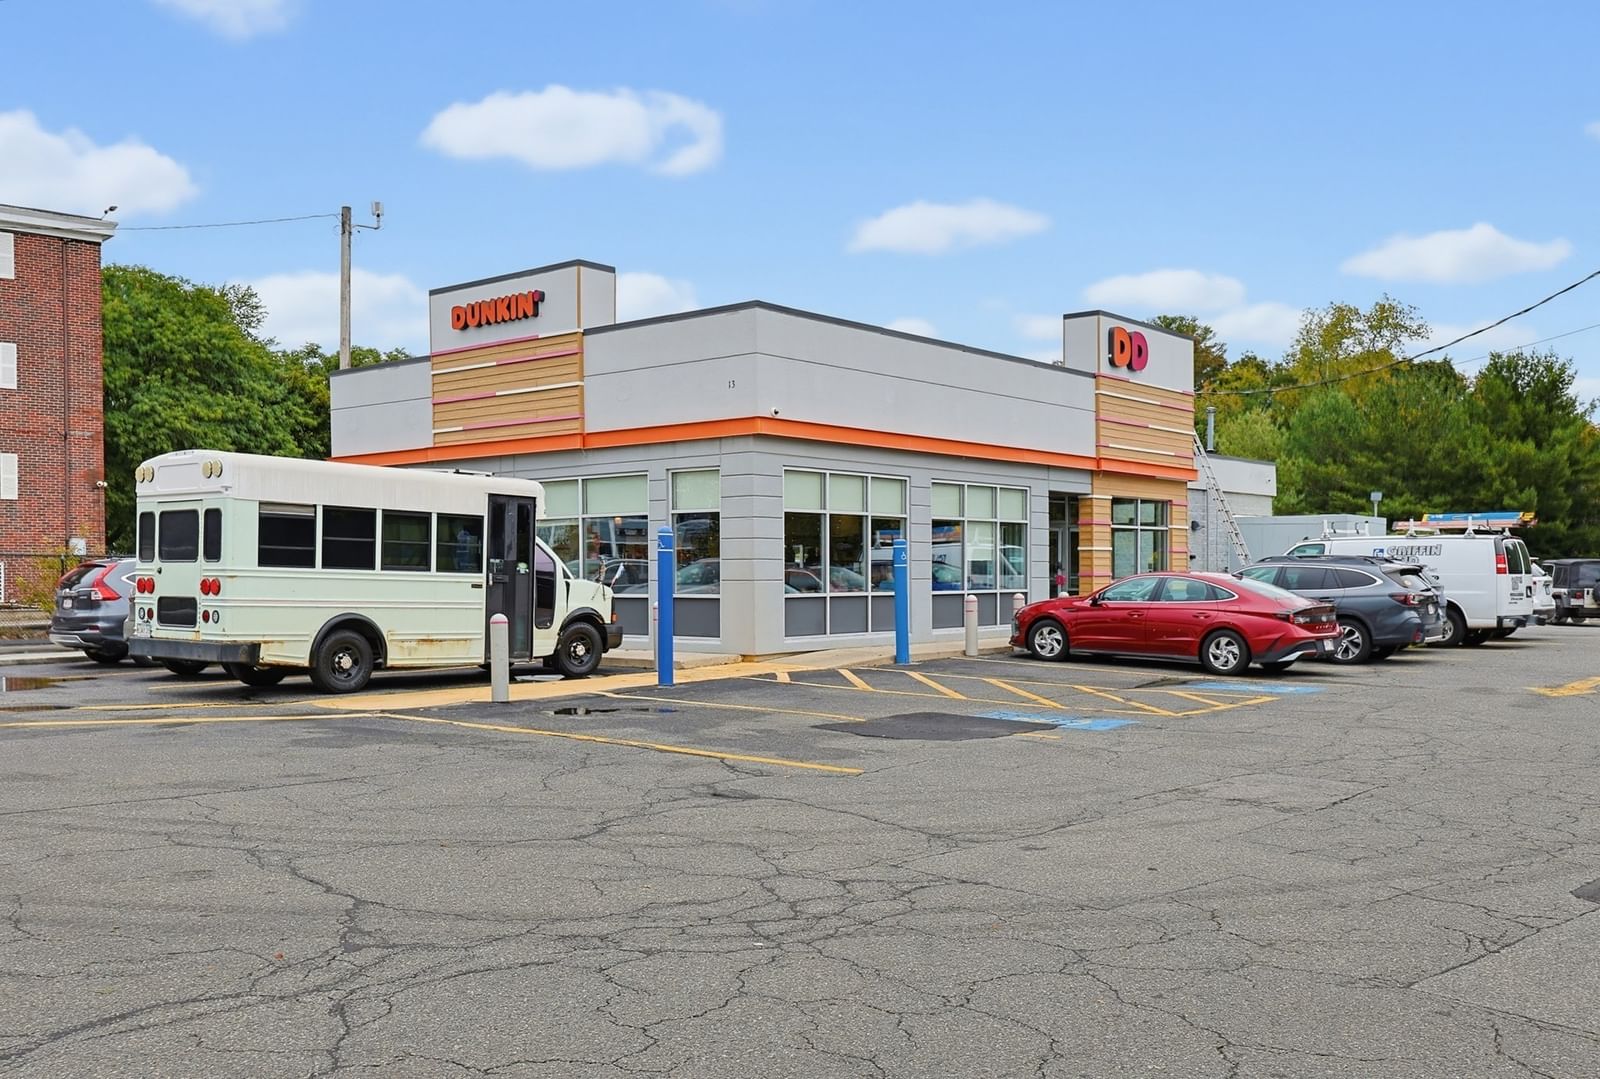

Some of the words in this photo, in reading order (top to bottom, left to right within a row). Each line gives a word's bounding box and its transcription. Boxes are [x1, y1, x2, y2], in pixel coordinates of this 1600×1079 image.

[452, 290, 545, 330] DUNKIN'
[1108, 326, 1148, 371] DD
[728, 380, 736, 389] 13
[1387, 544, 1442, 556] GRIFFIN
